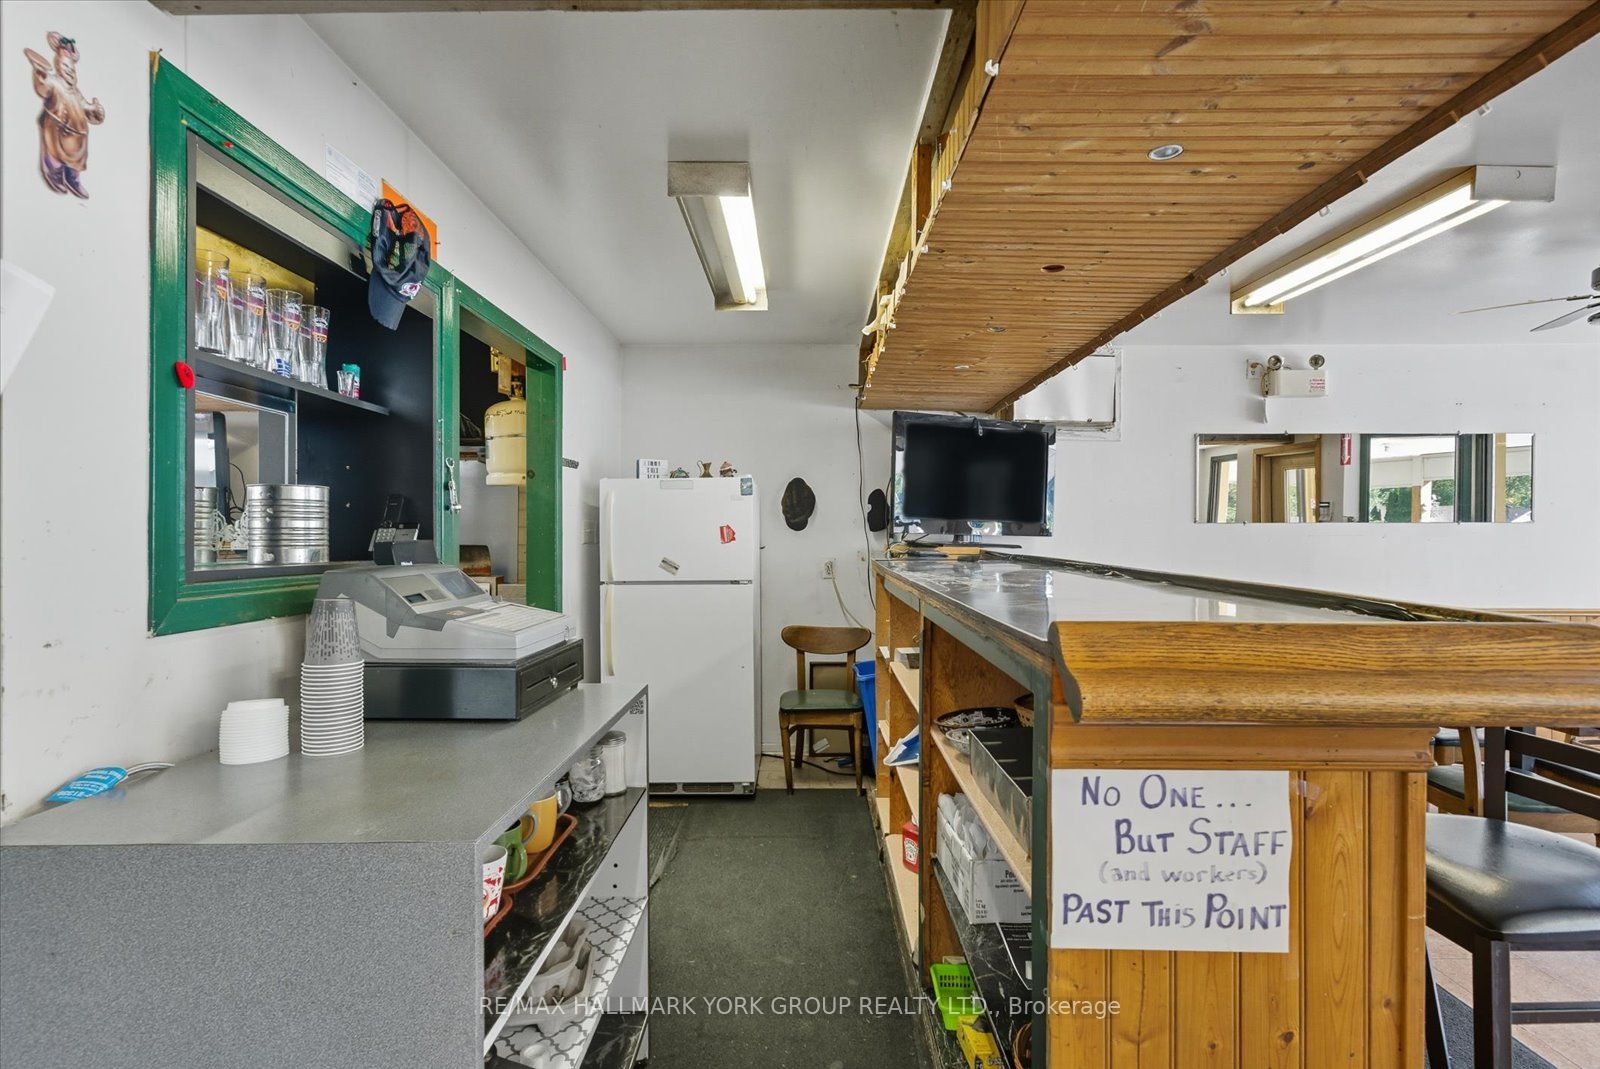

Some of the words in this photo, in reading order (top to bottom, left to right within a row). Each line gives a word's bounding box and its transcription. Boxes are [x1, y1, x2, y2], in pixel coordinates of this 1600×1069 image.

[1187, 817, 1288, 857] STAFF
[1099, 860, 1151, 884] (and
[1161, 860, 1268, 885] workers)
[1062, 893, 1130, 925] PAST
[1204, 893, 1287, 930] POINT
